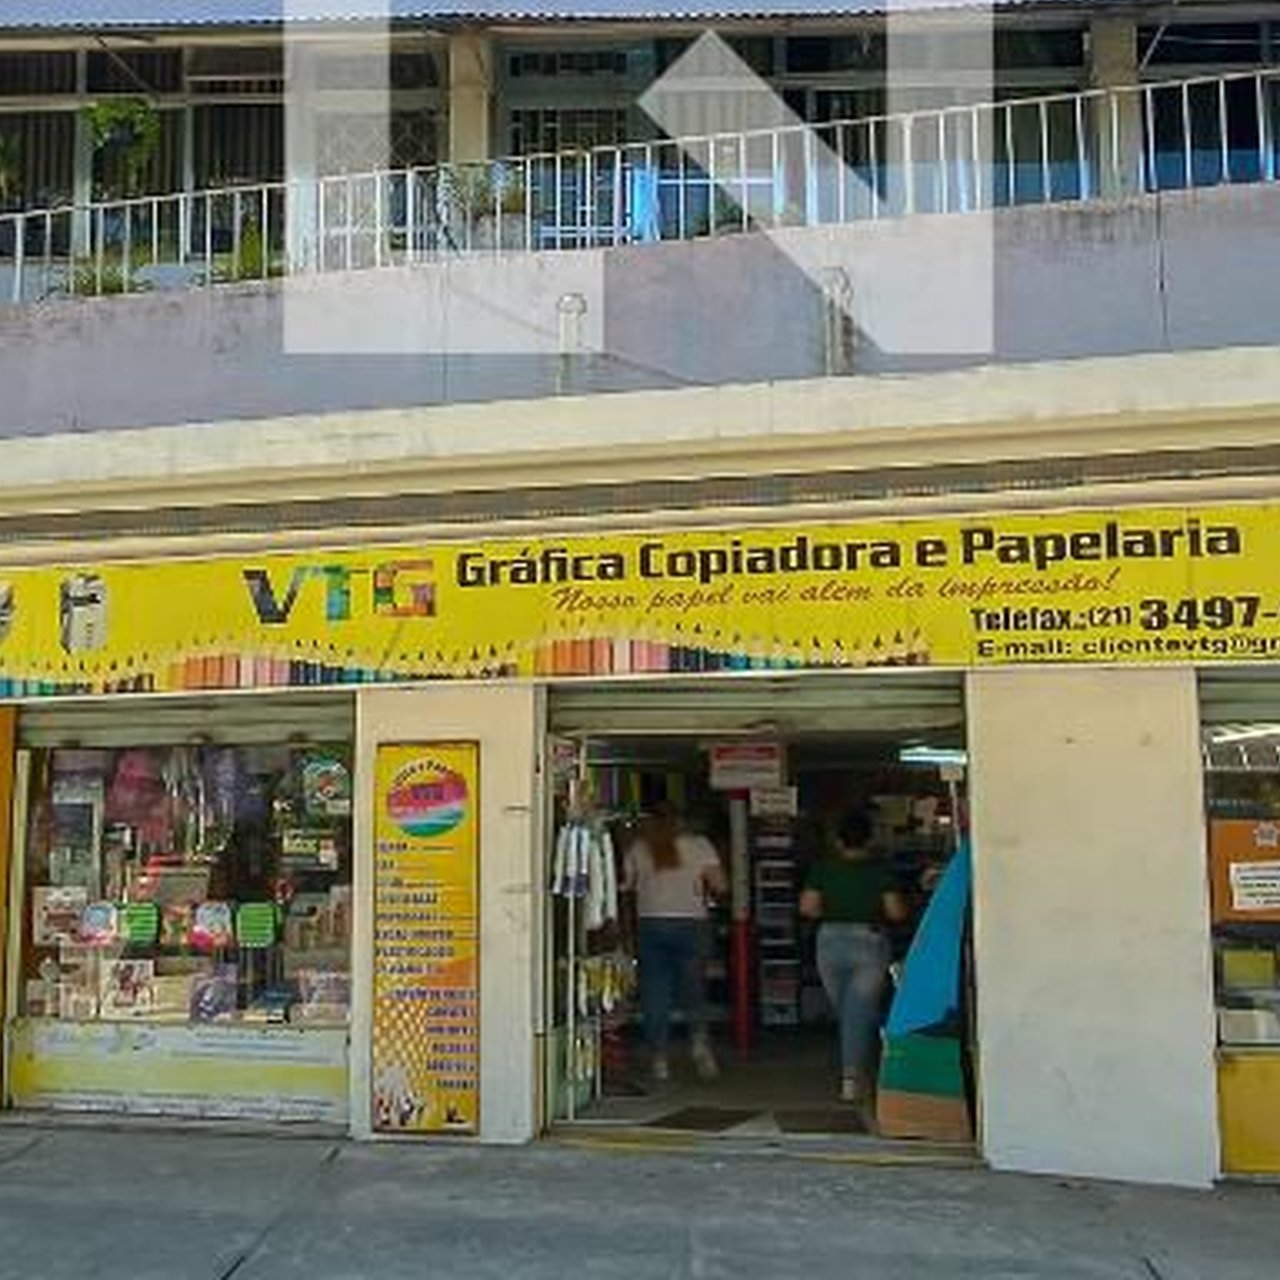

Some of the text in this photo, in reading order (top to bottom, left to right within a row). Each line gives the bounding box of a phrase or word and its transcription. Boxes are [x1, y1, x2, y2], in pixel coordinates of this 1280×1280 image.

[456, 519, 1242, 587] Gráfica Copiadora e Papelaria
[242, 559, 437, 625] VTG
